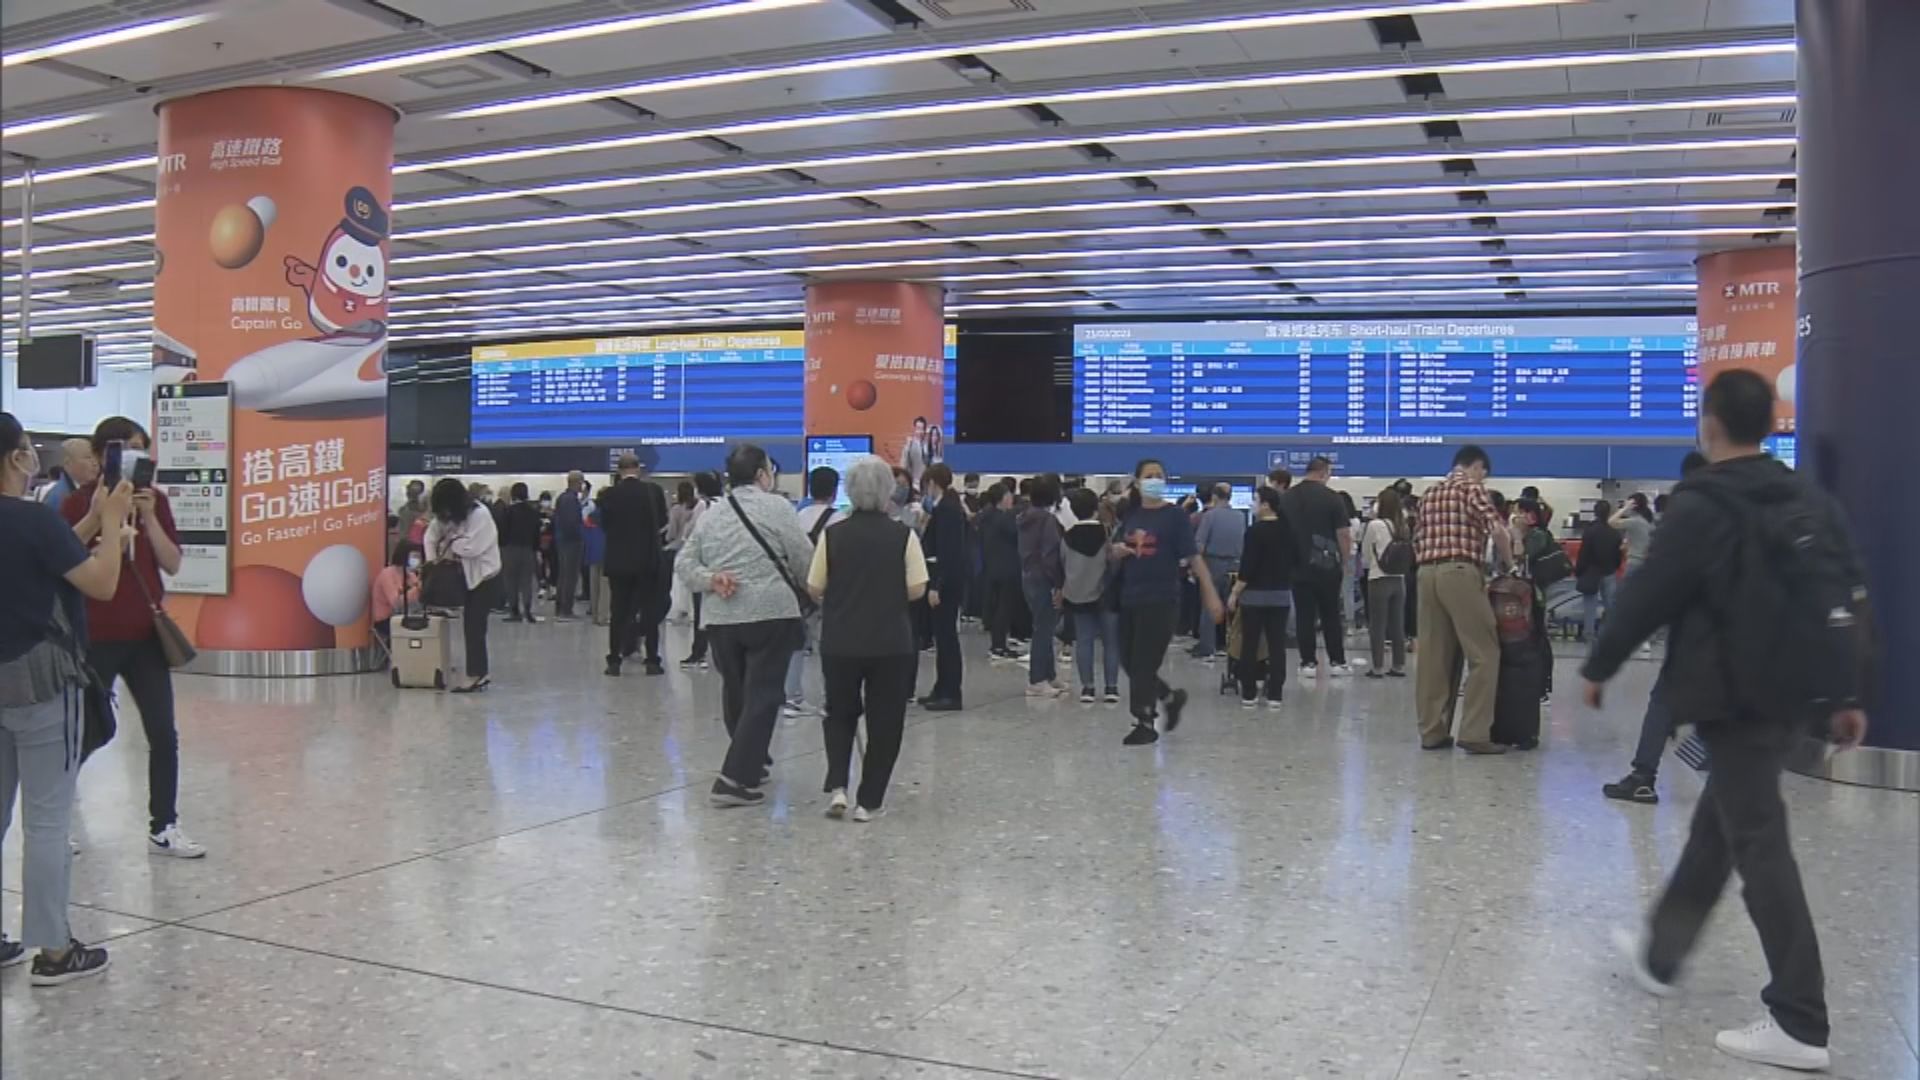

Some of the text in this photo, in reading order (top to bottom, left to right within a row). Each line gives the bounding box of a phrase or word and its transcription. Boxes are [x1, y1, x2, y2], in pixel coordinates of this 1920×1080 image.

[1740, 282, 1780, 297] MTR
[231, 316, 304, 332] Captain Go
[1414, 323, 1446, 336] Train
[1447, 323, 1515, 338] Departures
[242, 438, 345, 487] 搭高鐵
[241, 532, 262, 545] Go
[267, 518, 317, 542] Faster!
[323, 518, 343, 531] Go
